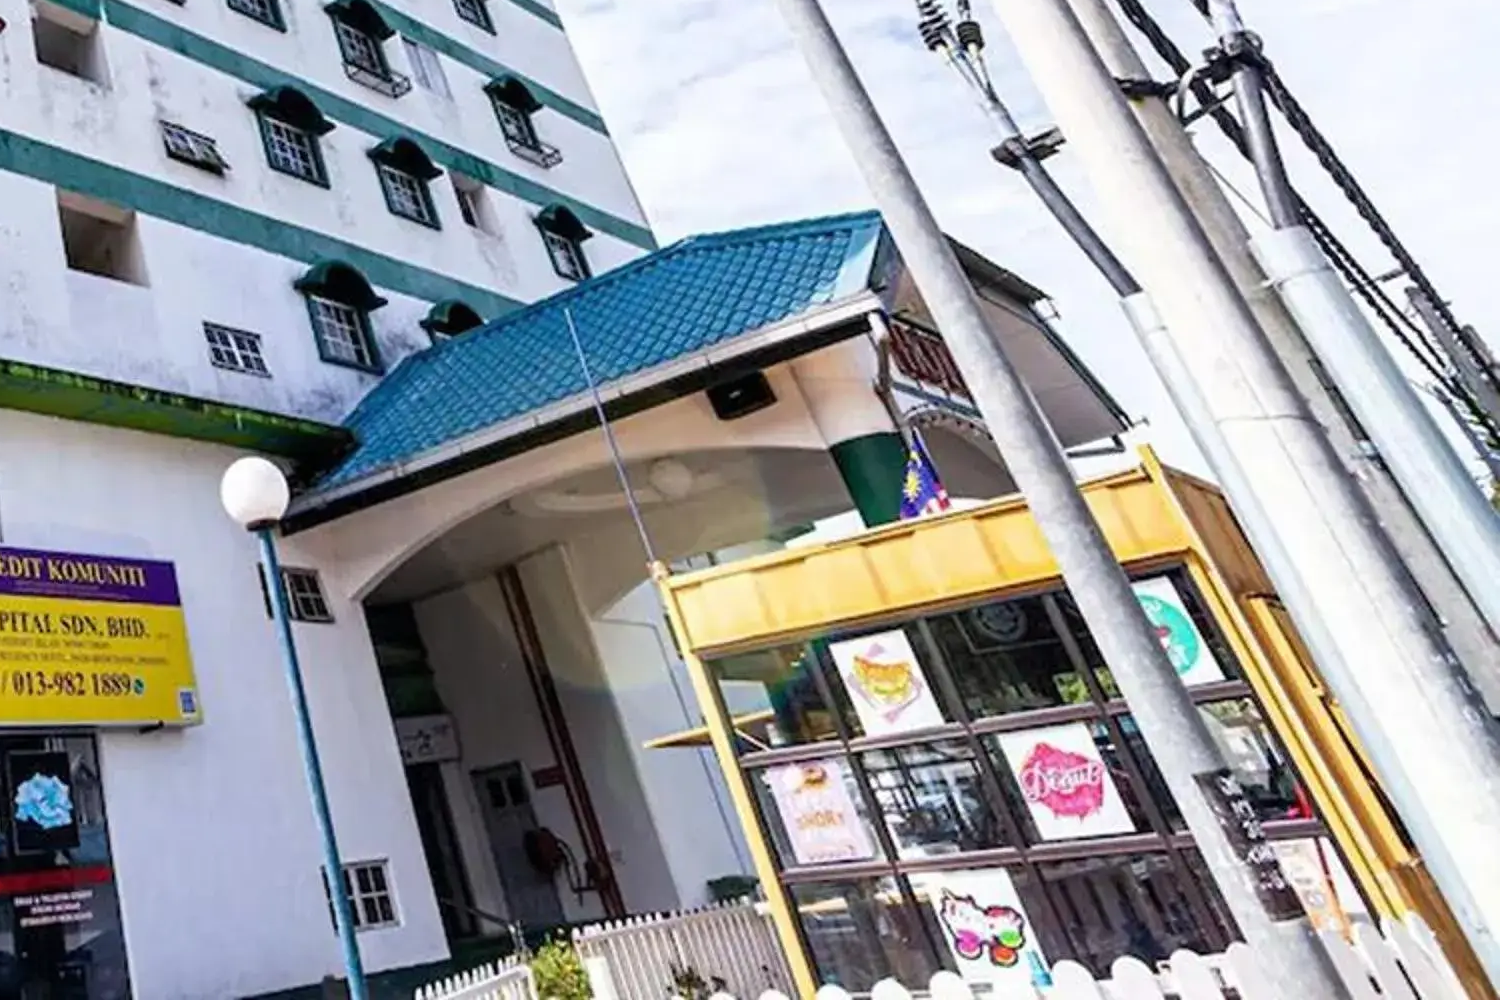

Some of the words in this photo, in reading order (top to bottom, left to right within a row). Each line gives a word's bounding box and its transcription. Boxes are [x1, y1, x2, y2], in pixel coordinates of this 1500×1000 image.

[47, 558, 147, 588] KOMUNITI
[59, 613, 104, 637] SDN.
[107, 616, 151, 639] BHD.
[12, 671, 86, 697] 013-982
[92, 673, 132, 698] 1889
